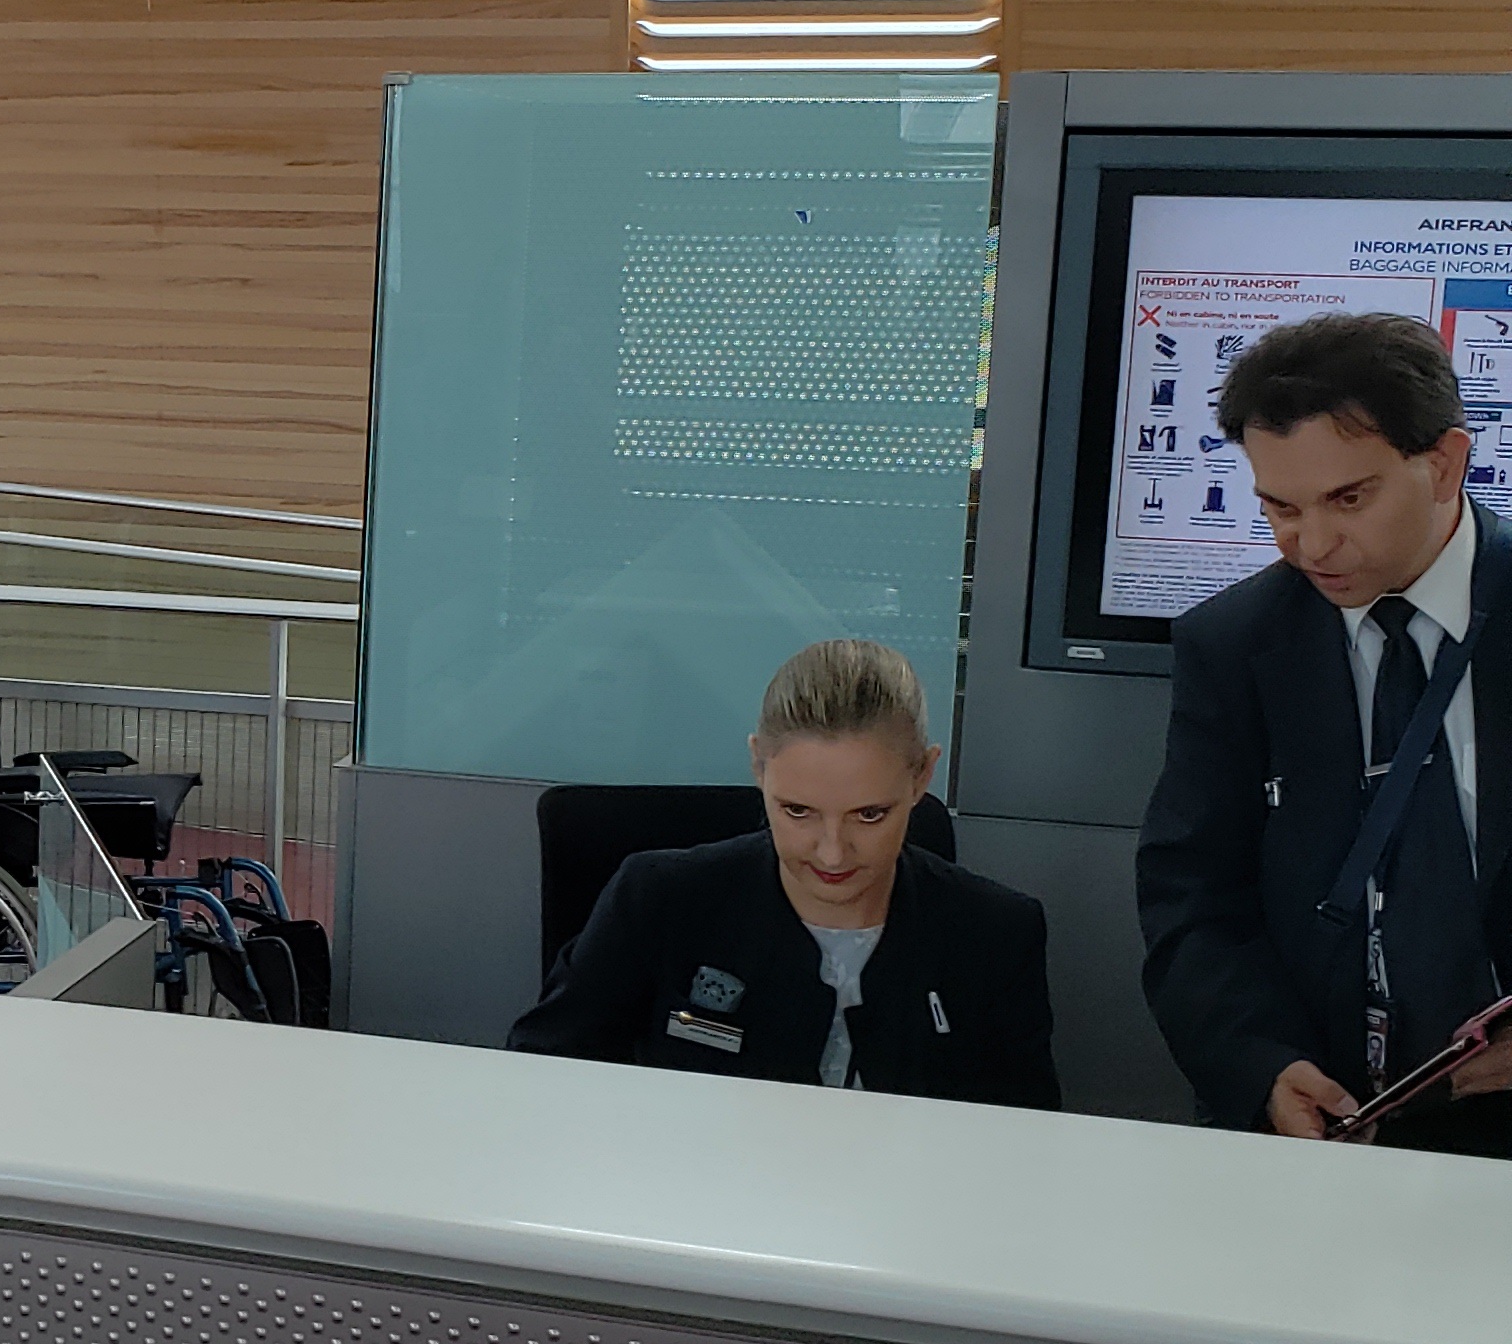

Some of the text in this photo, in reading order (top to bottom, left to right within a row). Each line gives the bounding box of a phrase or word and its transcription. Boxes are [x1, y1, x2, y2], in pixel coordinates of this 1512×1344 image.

[1354, 241, 1512, 256] INFORMATIONS ET
[1349, 259, 1512, 274] BAGGAGE INFORM
[1141, 277, 1301, 289] INTERDIT AU TRANSPORT
[1140, 290, 1346, 304] FORBIDDEN TO TRANSPORTATION
